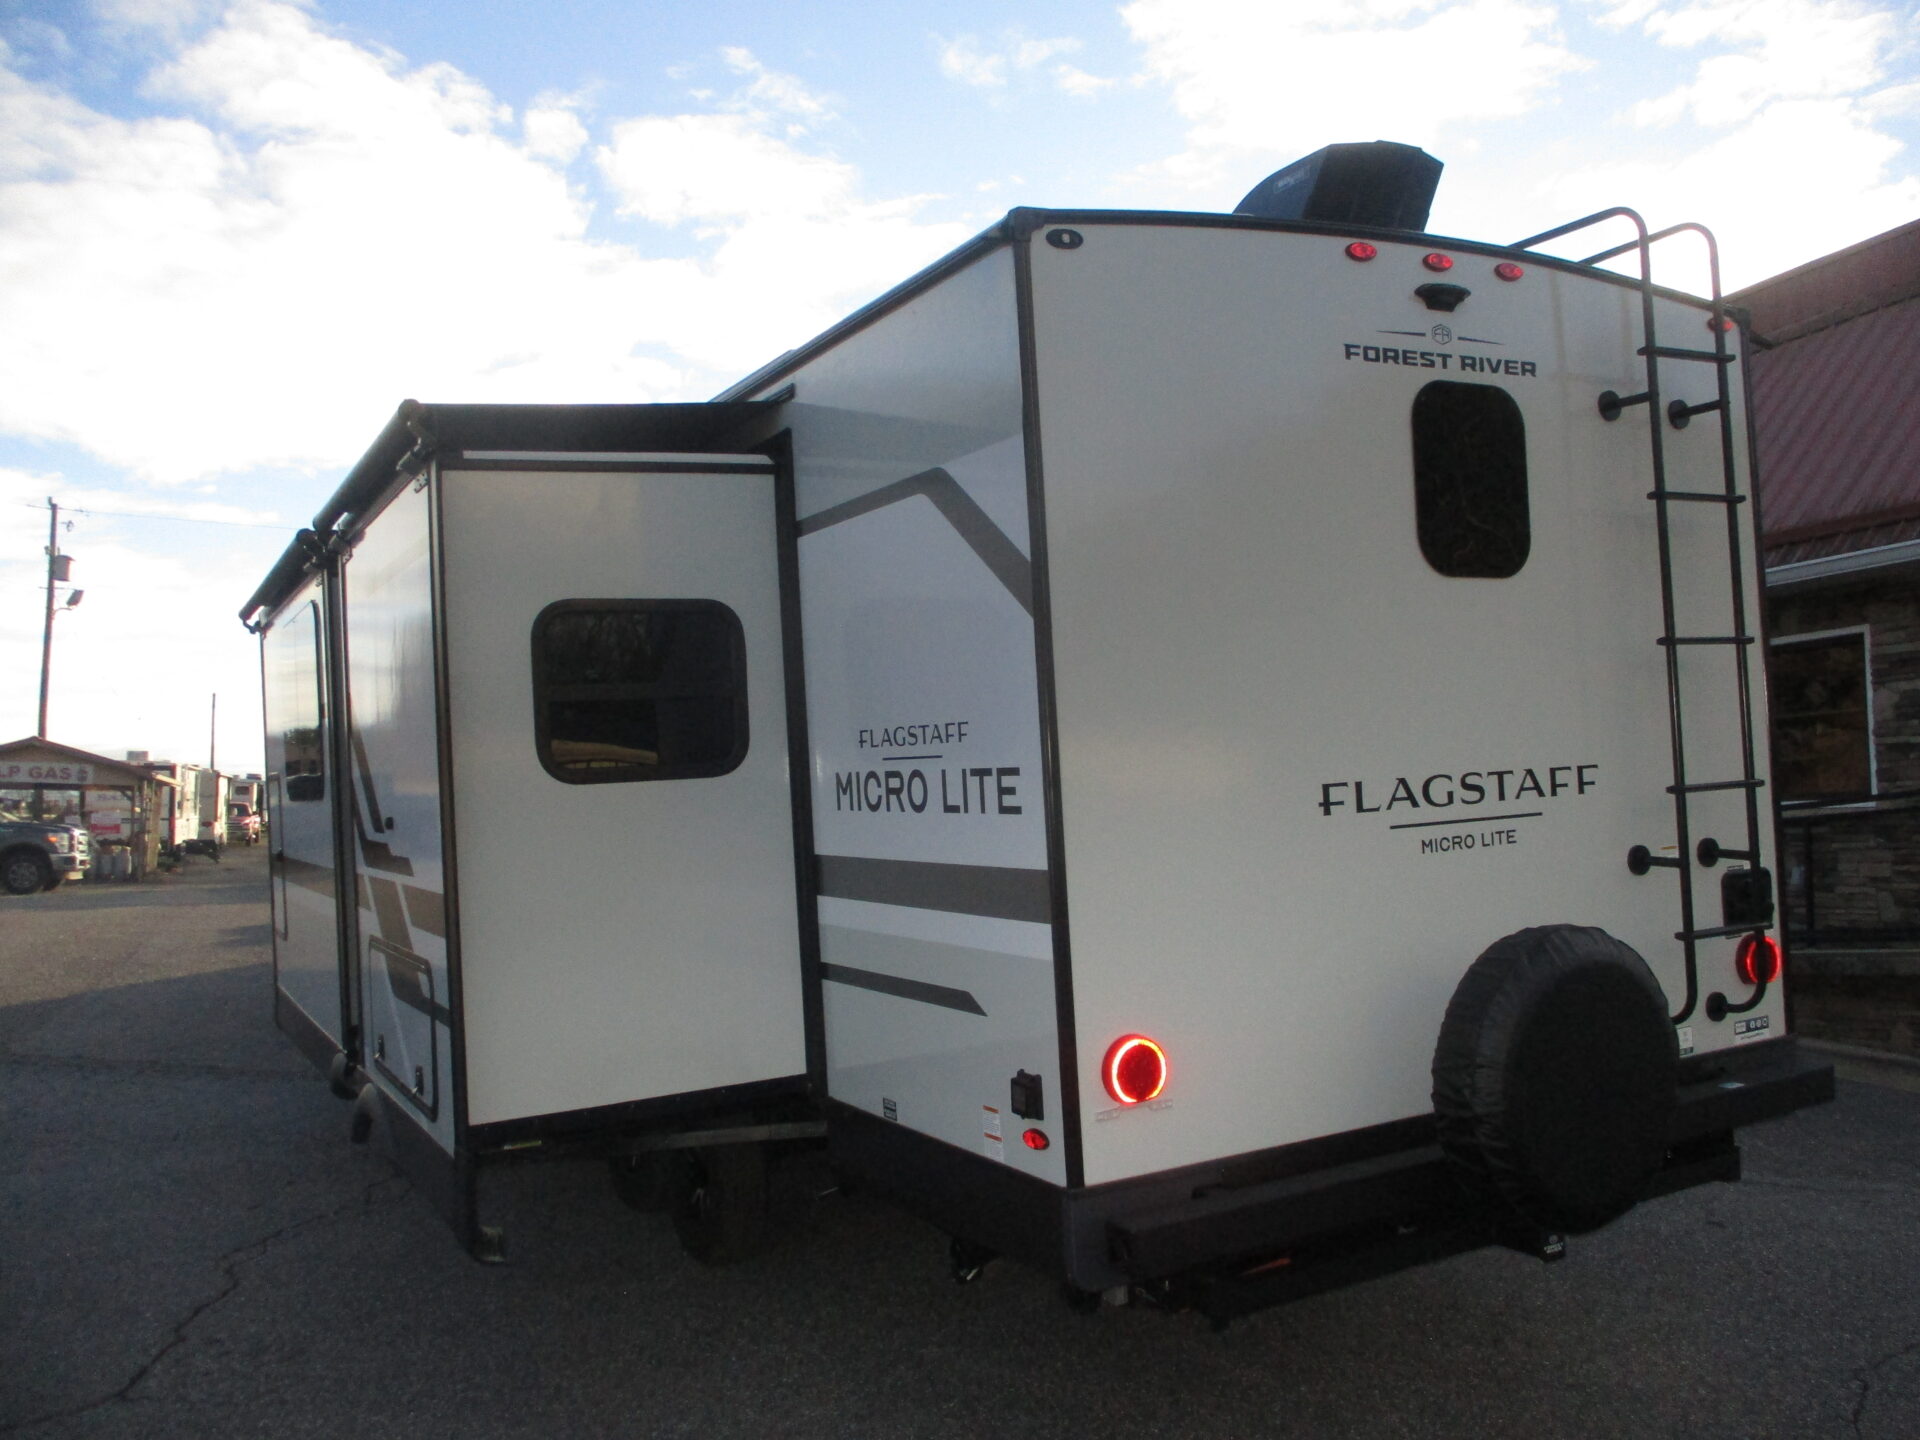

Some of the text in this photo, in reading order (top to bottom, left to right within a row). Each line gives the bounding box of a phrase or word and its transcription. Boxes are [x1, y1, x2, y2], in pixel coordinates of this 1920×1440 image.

[1343, 343, 1537, 377] FOREST RIVER
[858, 721, 969, 749] FLAGSTAFF
[28, 766, 73, 780] GAS
[835, 766, 1023, 815] MICRO LITE
[1318, 763, 1599, 817] FLAGSTAFF
[1421, 829, 1517, 854] MICRO LITE
